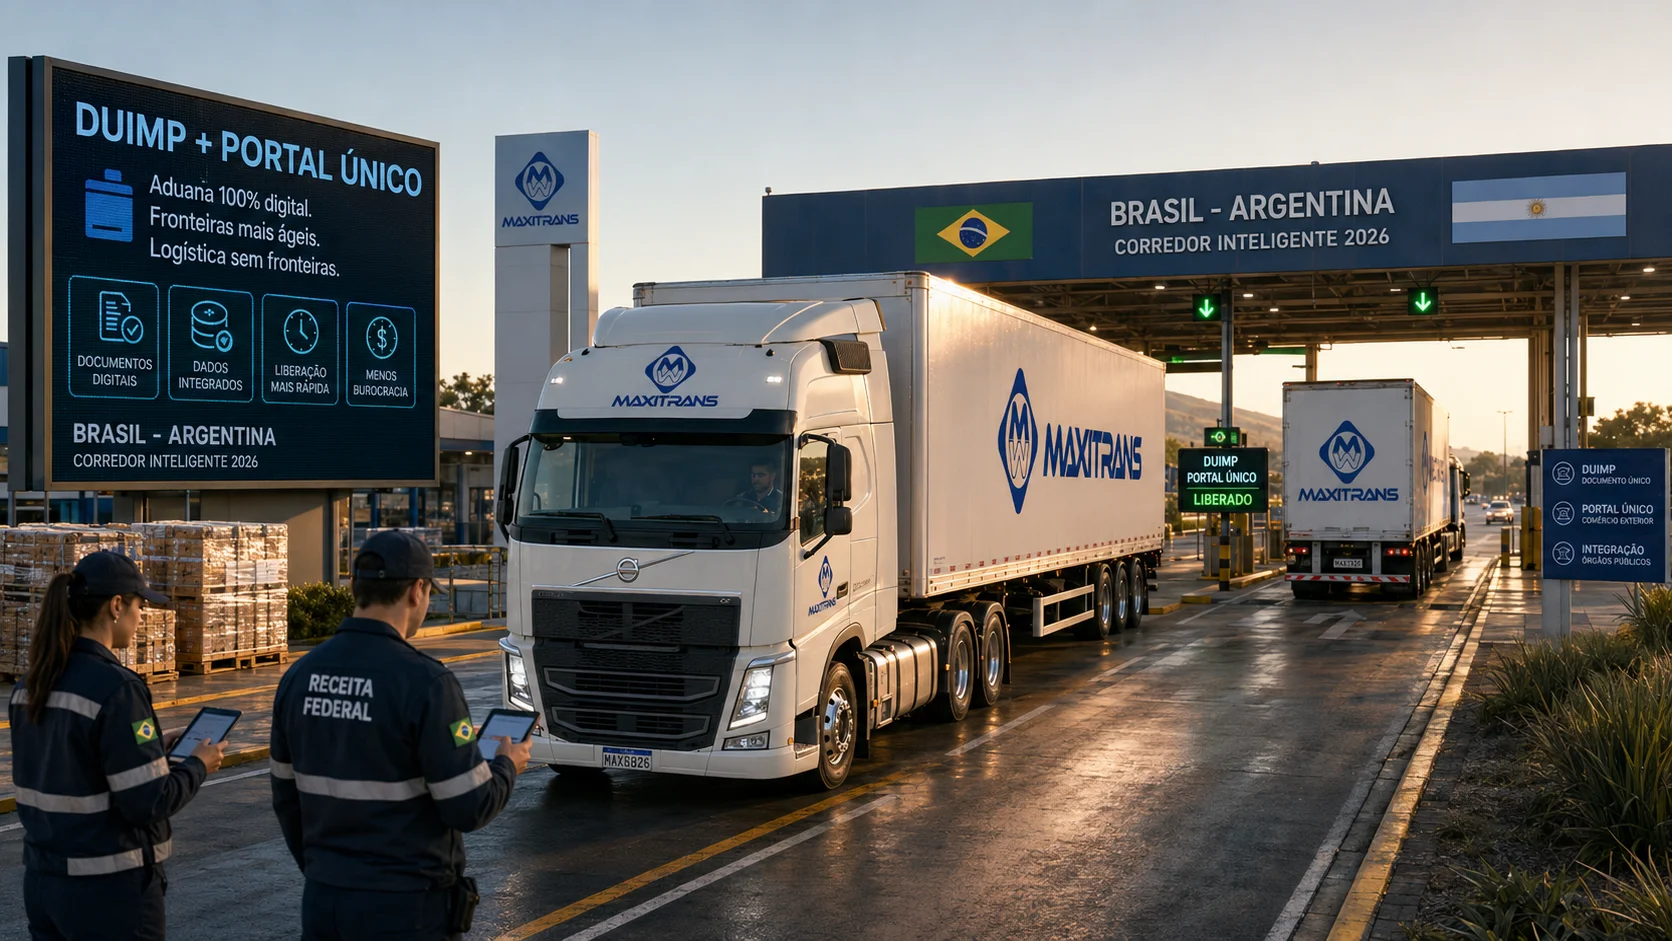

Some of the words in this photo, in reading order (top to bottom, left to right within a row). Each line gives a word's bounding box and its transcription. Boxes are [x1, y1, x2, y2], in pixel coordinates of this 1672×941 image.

[75, 101, 187, 154] DUIMP
[195, 133, 212, 155] +
[221, 131, 333, 181] PORTAL
[340, 148, 422, 197] ÚNICO
[150, 174, 214, 203] Aduana
[219, 186, 260, 210] 100%
[265, 194, 312, 218] digital.
[1111, 198, 1204, 226] BRASIL
[1229, 187, 1395, 221] ARGENTINA
[150, 206, 234, 235] Fronteiras
[238, 221, 274, 241] mais
[278, 224, 320, 248] ágeis.
[502, 214, 579, 228] MAXITRANS
[1114, 235, 1211, 255] CORREDOR
[1218, 230, 1338, 251] INTELIGENTE
[1344, 228, 1390, 246] 2026
[150, 237, 226, 265] Logística
[231, 252, 263, 269] sem
[267, 251, 340, 277] fronteiras.
[77, 355, 153, 370] DOCUMENTOS
[193, 361, 229, 374] DADOS
[275, 364, 327, 380] LIBERAÇÃO
[366, 369, 397, 382] MENOS
[92, 374, 137, 387] DIGITAIS
[179, 377, 243, 391] INTEGRADOS
[271, 381, 294, 393] MAIS
[296, 379, 330, 394] RÁPIDA
[353, 385, 408, 397] BUROCRACIA
[611, 395, 719, 407] MAXITRANS
[73, 423, 146, 445] BRASIL
[168, 425, 276, 446] ARGENTINA
[1043, 422, 1142, 480] MAXITRANS
[73, 453, 146, 468] CORREDOR
[150, 454, 228, 468] INTELIGENTE
[231, 454, 258, 468] 2026
[1203, 455, 1238, 467] DUIMP
[1187, 472, 1224, 483] PORTAL
[1226, 469, 1257, 483] ÚNICO
[1582, 464, 1616, 474] DUIMP
[1628, 475, 1651, 485] ÚNICO
[1194, 493, 1253, 506] LIBERADO
[1298, 488, 1399, 502] MAXITRANS
[1582, 504, 1619, 514] PORTAL
[1622, 502, 1653, 514] ÚNICO
[1582, 543, 1644, 556] INTEGRAÇÃO
[308, 673, 374, 698] RECEITA
[303, 697, 372, 722] FEDERAL
